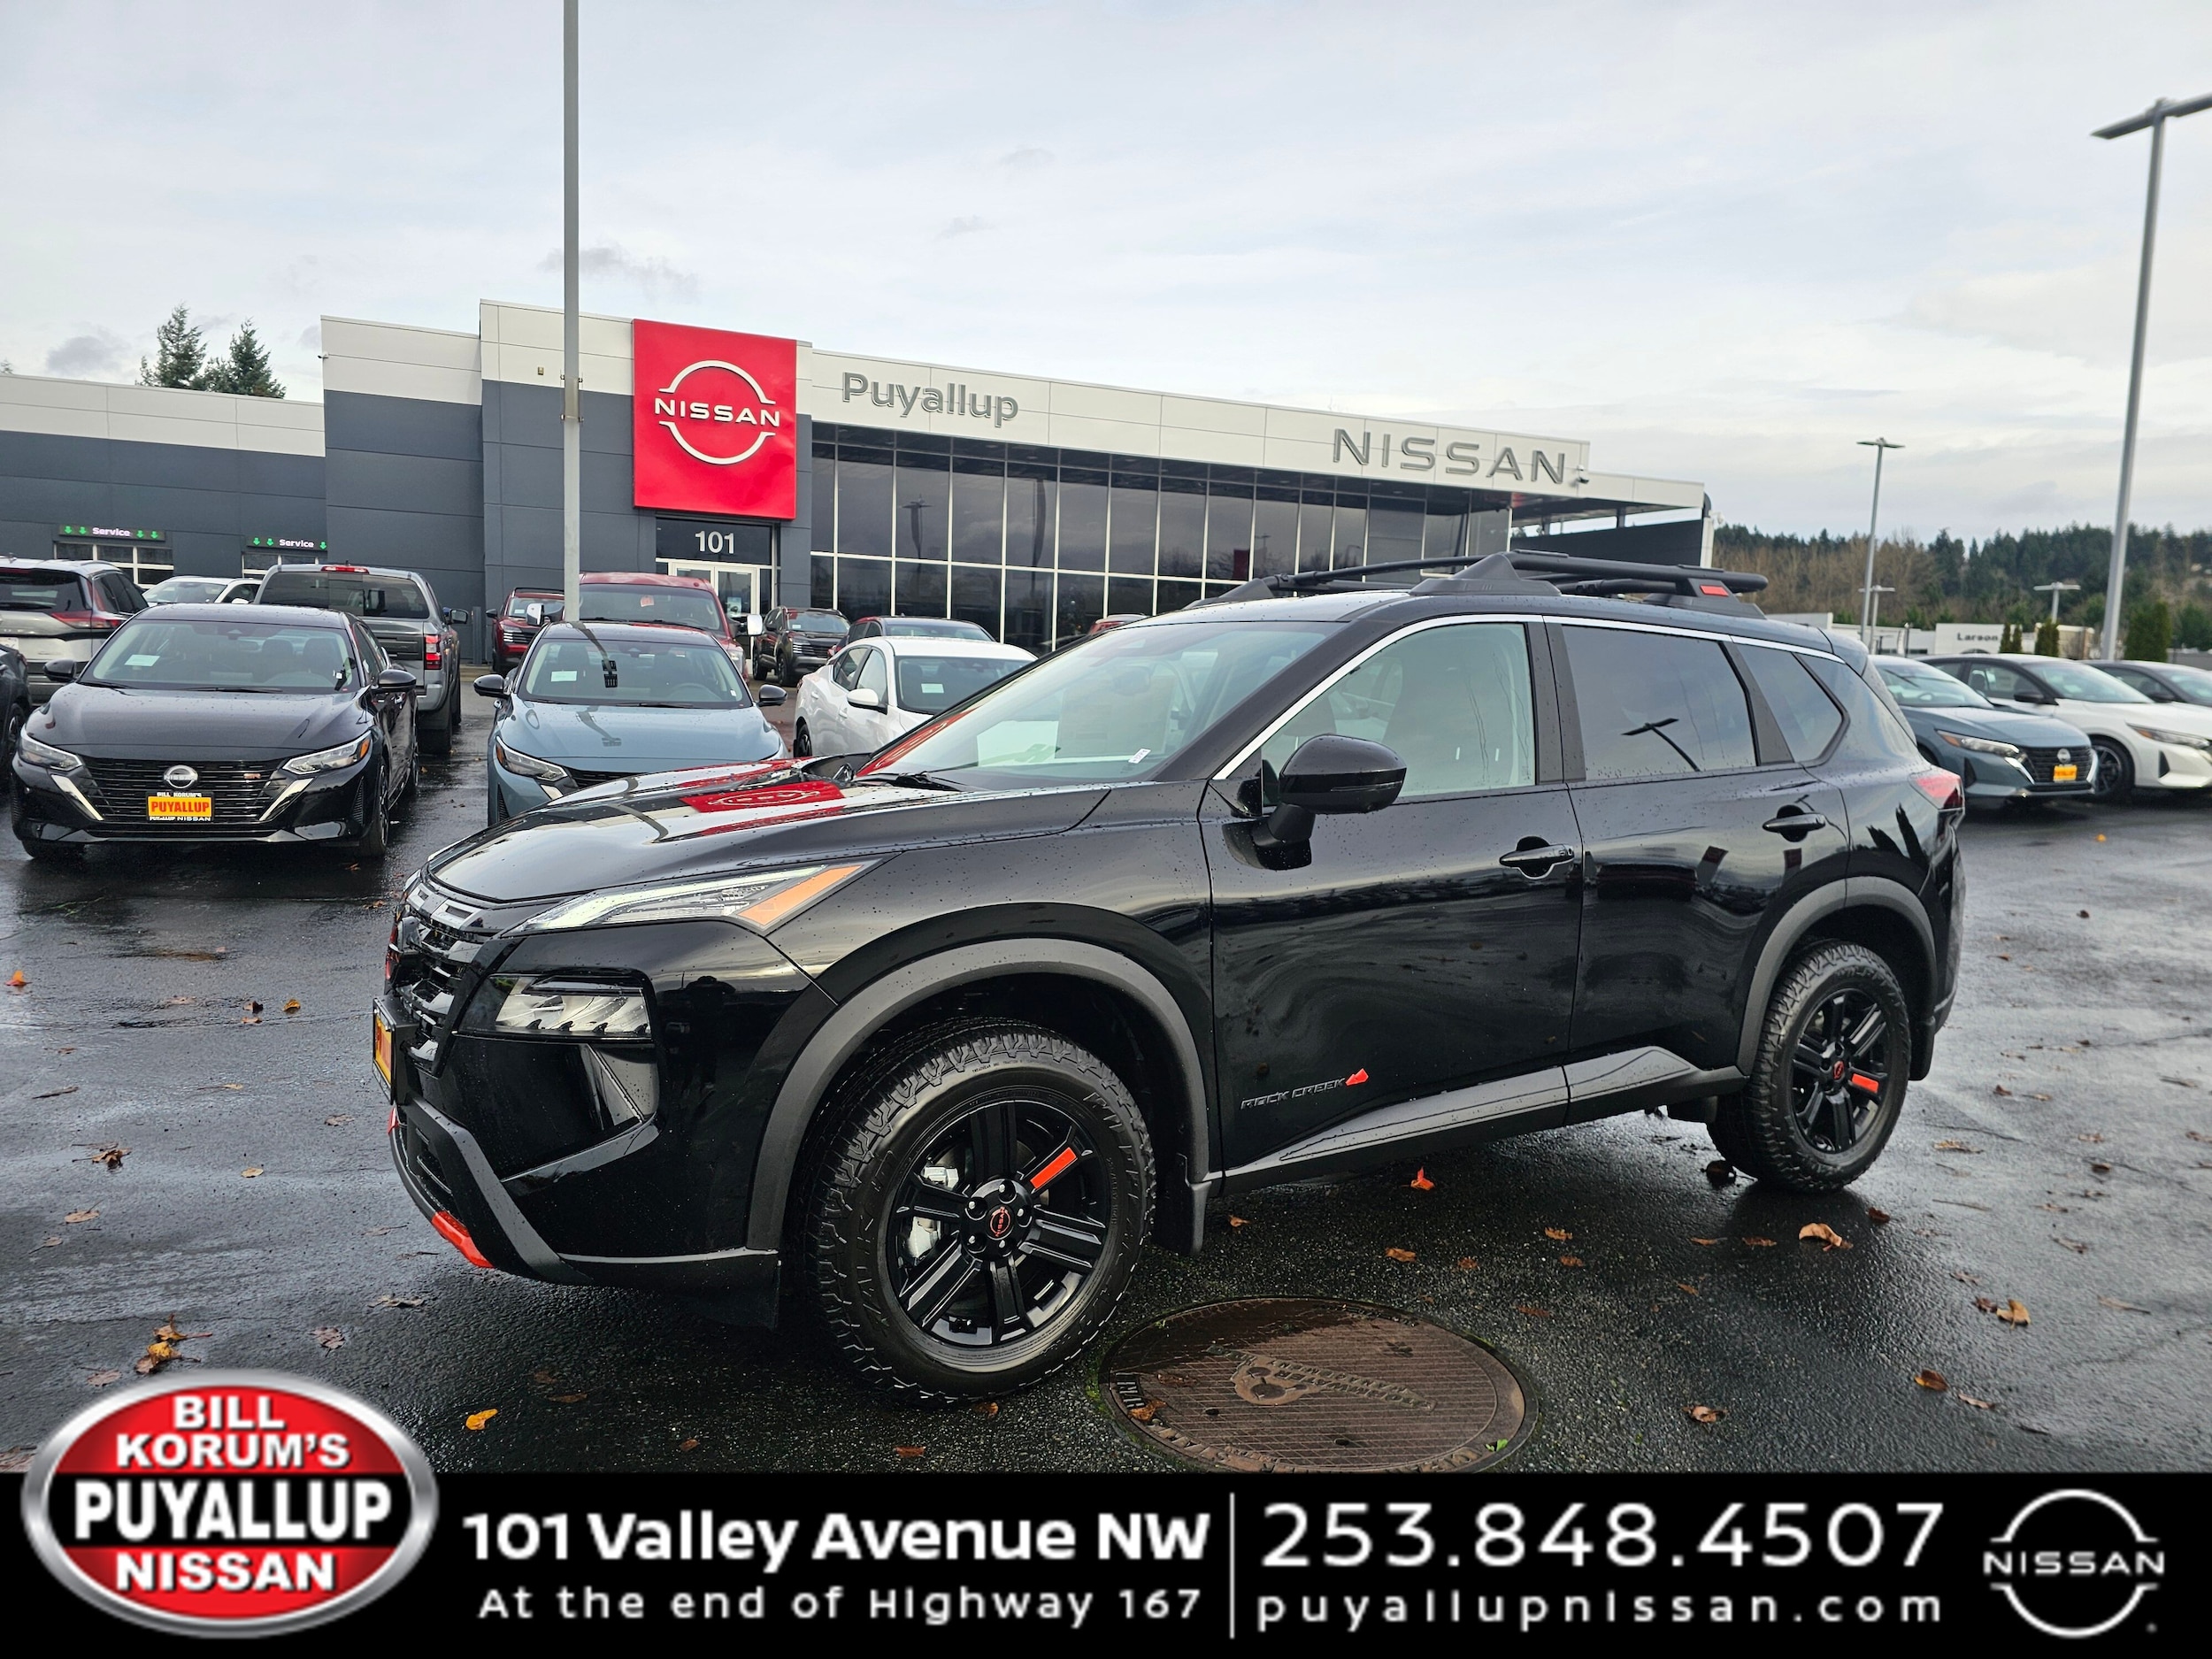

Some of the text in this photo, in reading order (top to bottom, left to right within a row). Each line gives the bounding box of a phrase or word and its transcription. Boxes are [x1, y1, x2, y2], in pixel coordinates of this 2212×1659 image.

[842, 372, 1019, 427] Puyallup
[655, 398, 780, 427] NISSAN
[1333, 428, 1564, 484] NISSAN
[92, 526, 131, 538] Service
[279, 538, 315, 549] Service
[695, 531, 734, 554] 101
[1957, 632, 1999, 641] Larson
[151, 801, 210, 812] PUYALLUP
[1240, 1077, 1346, 1110] ROCK CREEK
